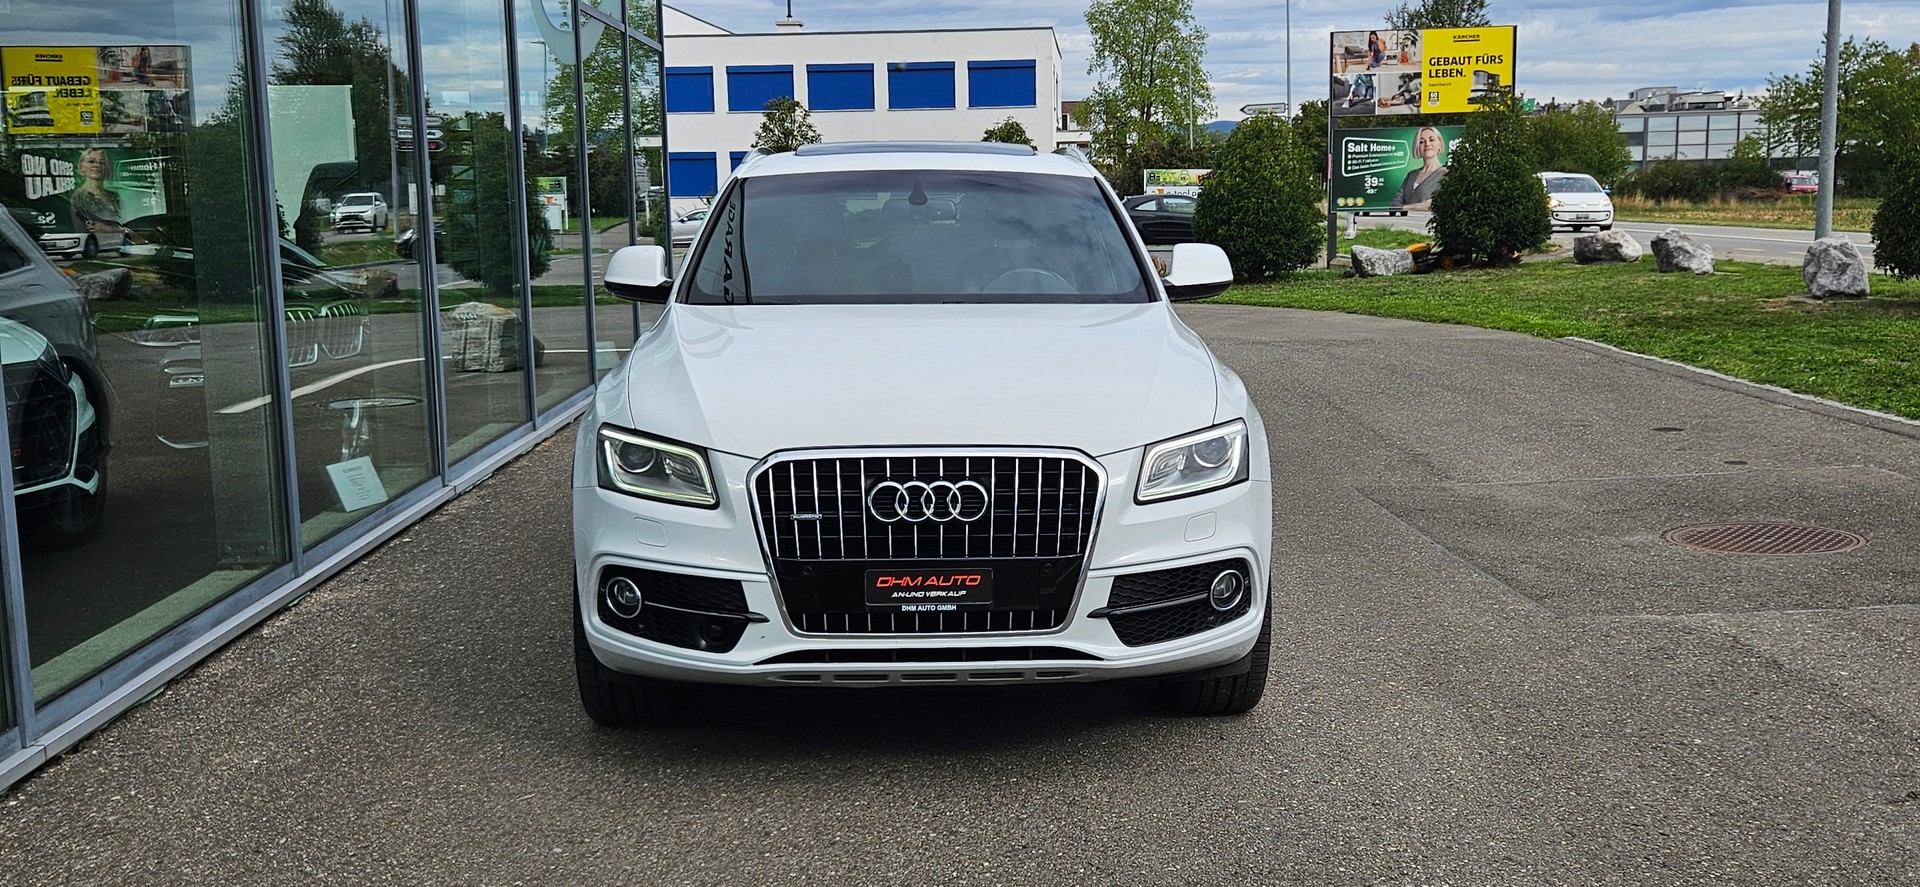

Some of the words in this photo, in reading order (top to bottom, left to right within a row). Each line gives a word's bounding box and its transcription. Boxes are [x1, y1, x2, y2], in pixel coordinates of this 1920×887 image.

[1429, 56, 1473, 67] GEBAUT
[1475, 53, 1504, 65] FÜRS
[1428, 68, 1466, 78] LEBEN.
[1347, 142, 1368, 153] Salt
[1370, 143, 1396, 152] Home+
[876, 576, 923, 587] DHM
[924, 575, 981, 587] AUTO
